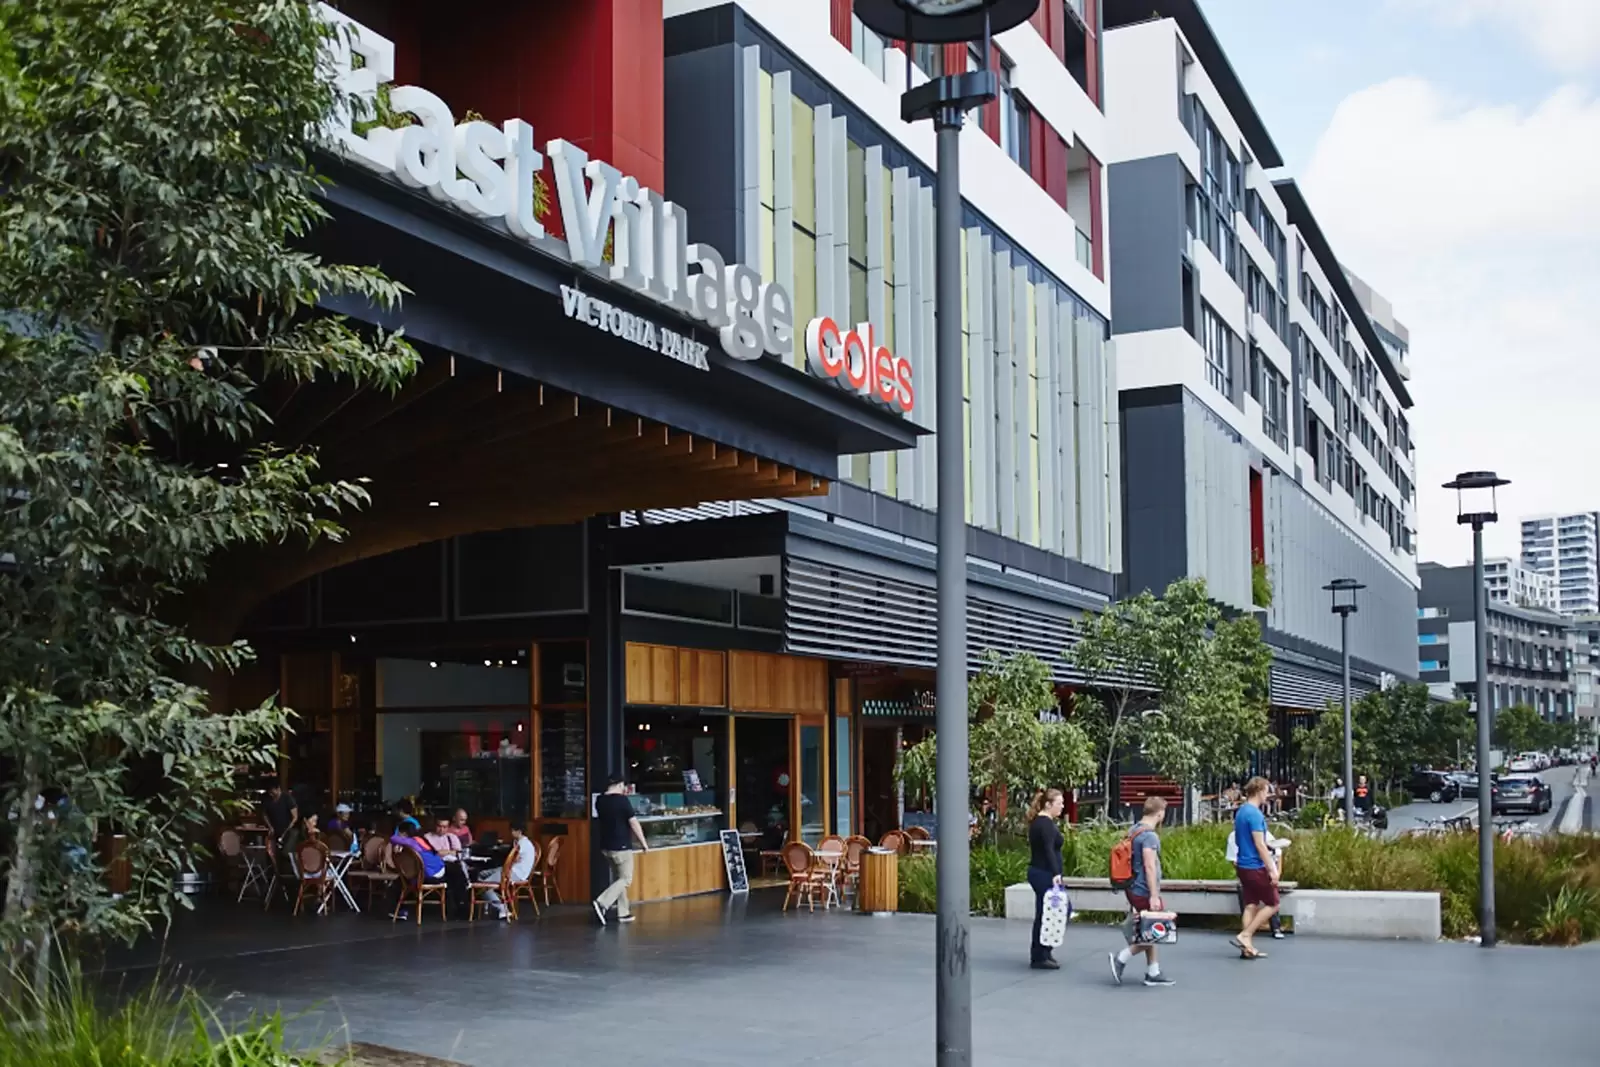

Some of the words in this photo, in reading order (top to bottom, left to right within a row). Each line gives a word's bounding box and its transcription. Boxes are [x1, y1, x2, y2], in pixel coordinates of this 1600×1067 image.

[308, 1, 545, 239] East
[547, 138, 793, 360] Village
[560, 284, 658, 352] VICTORIA
[660, 327, 710, 372] PARK
[805, 316, 914, 412] coles
